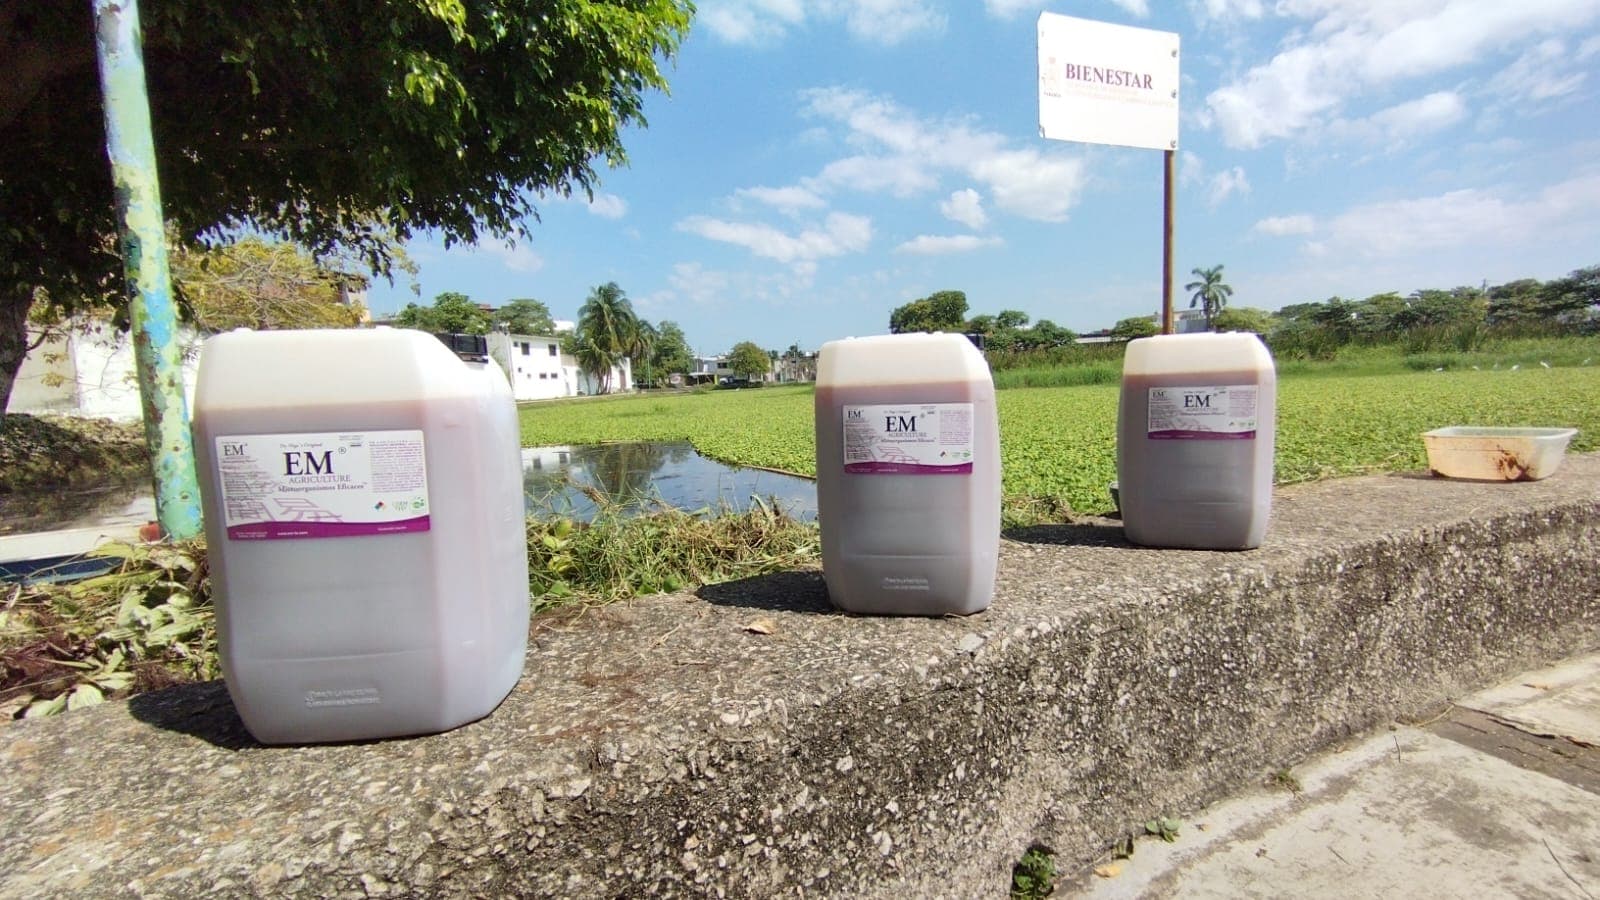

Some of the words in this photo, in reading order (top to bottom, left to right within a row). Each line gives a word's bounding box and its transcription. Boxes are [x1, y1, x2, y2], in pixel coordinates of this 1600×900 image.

[1065, 63, 1153, 90] BIENESTAR
[1184, 394, 1211, 408] EM
[847, 410, 861, 418] EM
[885, 415, 917, 432] EM
[223, 445, 245, 456] EM
[283, 450, 334, 475] EM
[289, 474, 351, 484] AGRICULTURE
